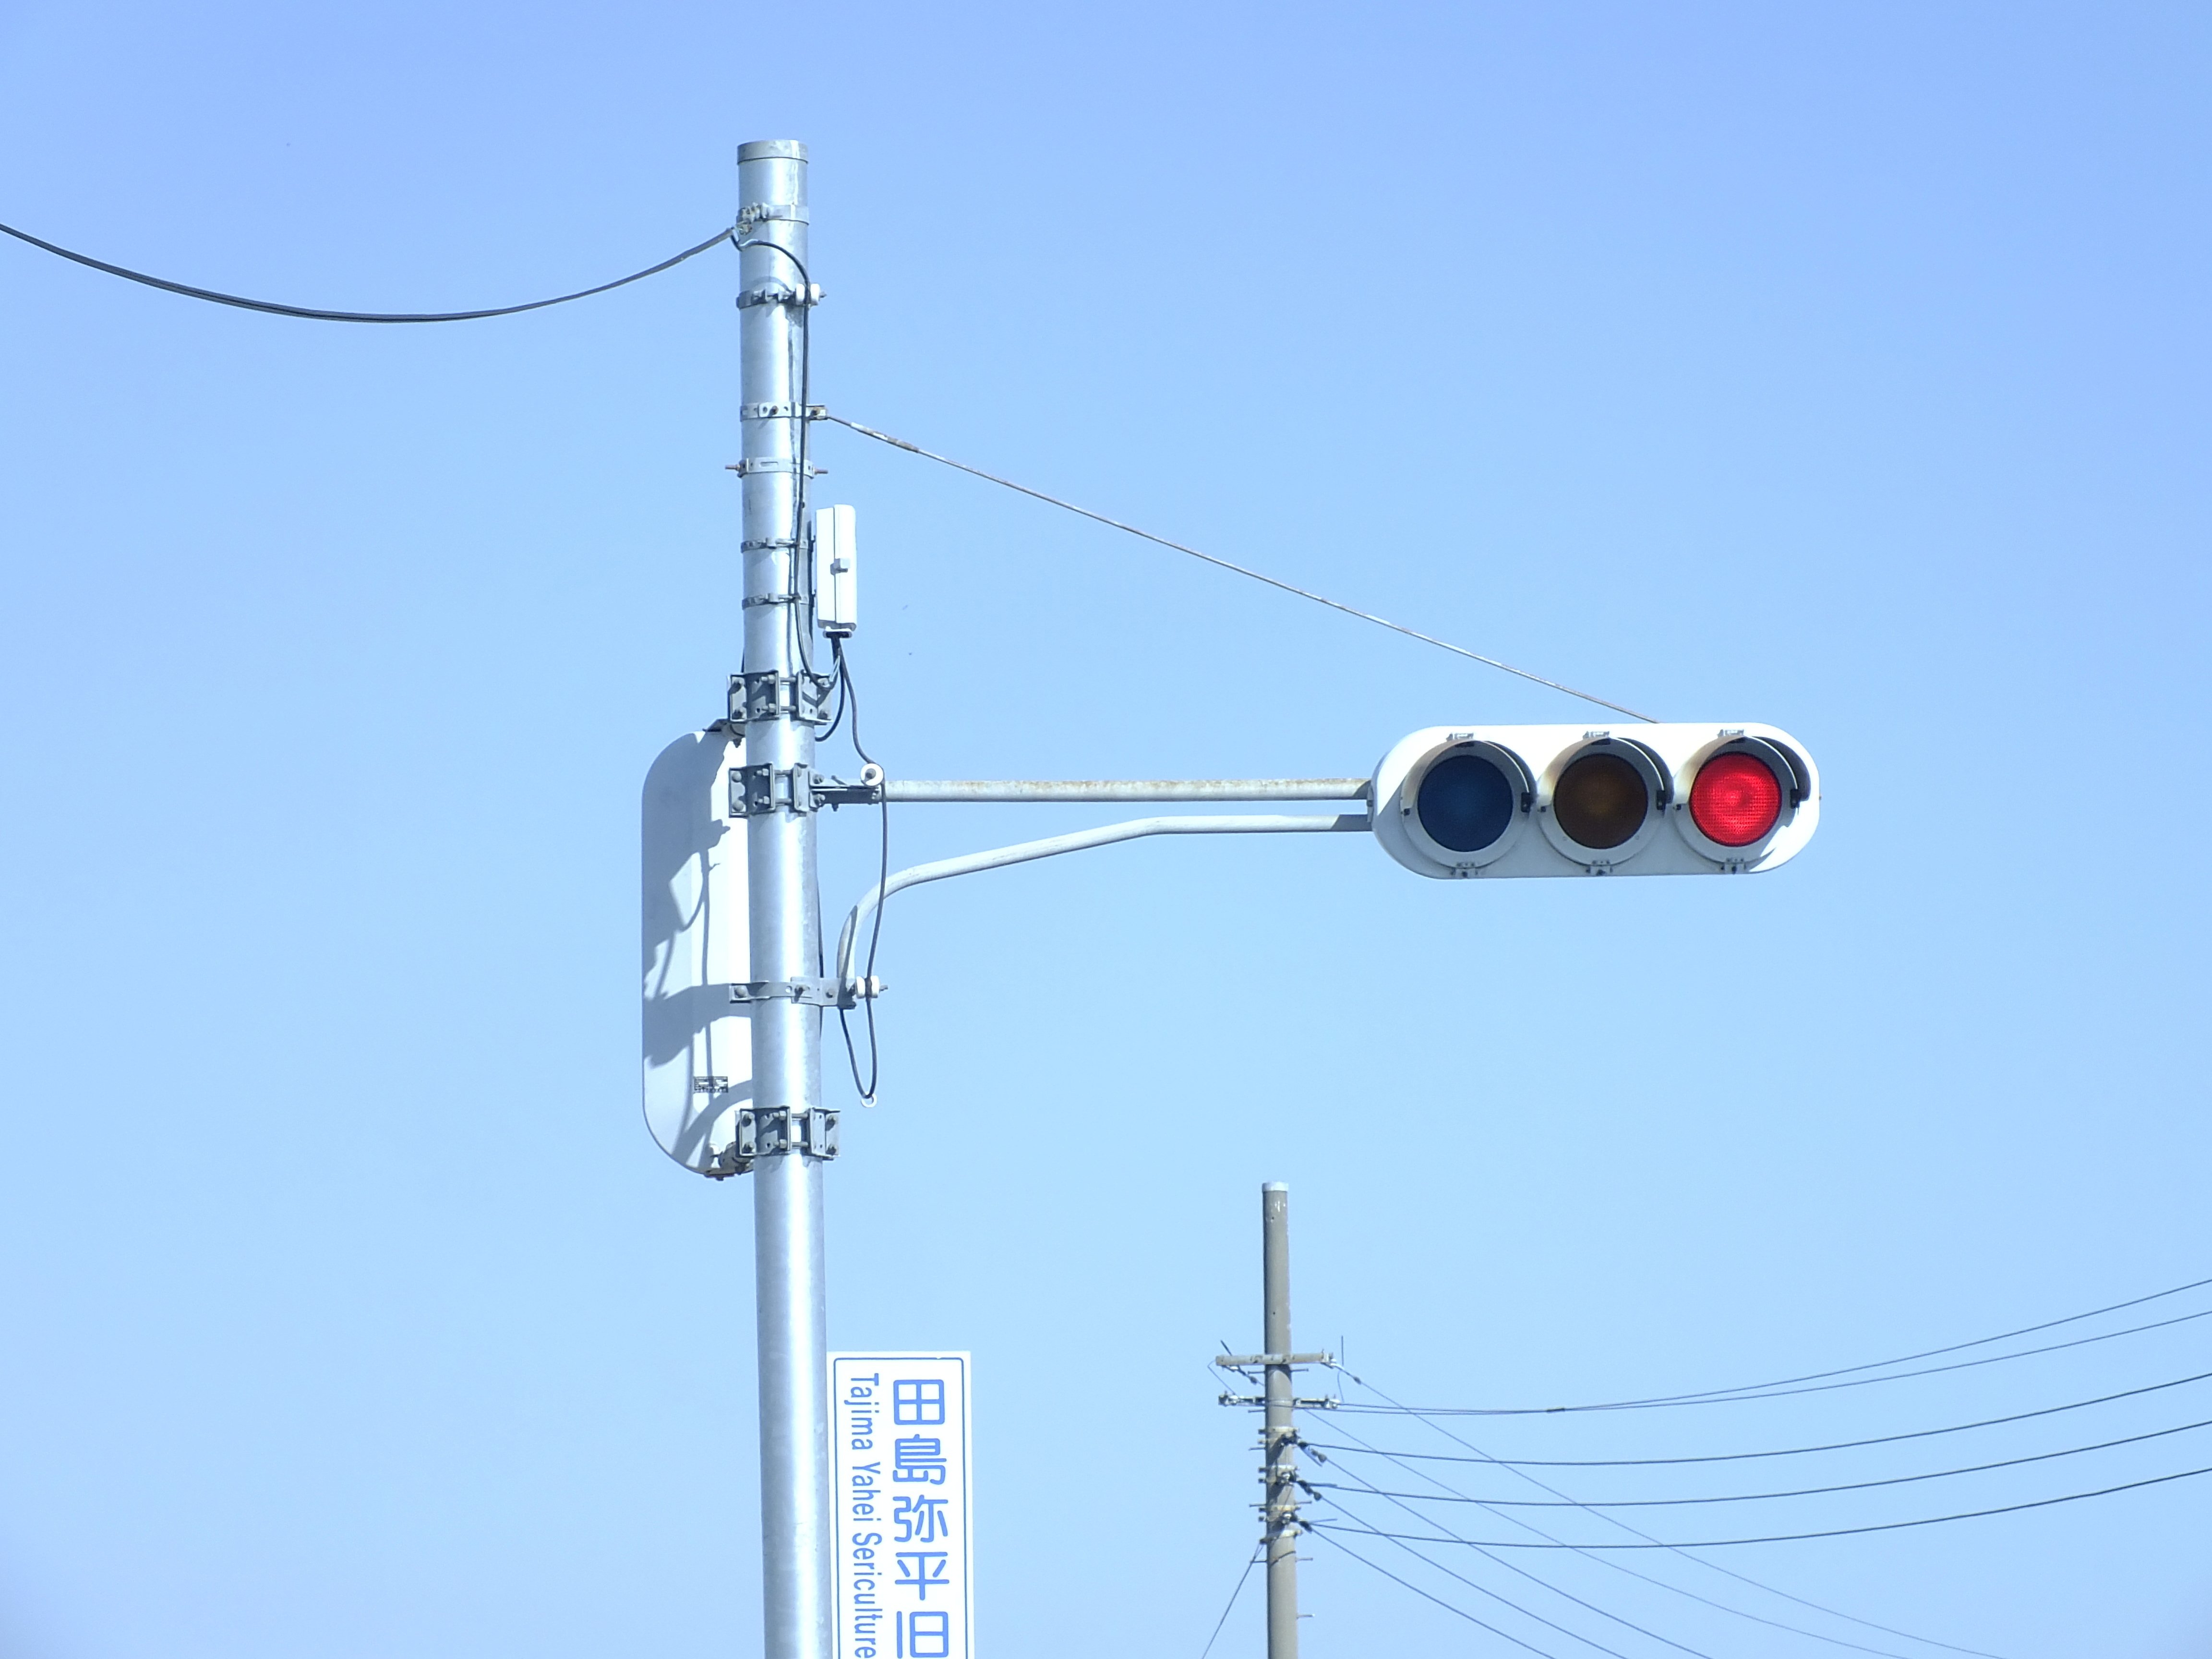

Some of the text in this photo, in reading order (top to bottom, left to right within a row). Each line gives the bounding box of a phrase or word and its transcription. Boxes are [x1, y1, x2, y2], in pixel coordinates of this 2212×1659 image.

[844, 1373, 883, 1659] Tajima Yahei Sericulture
[892, 1379, 950, 1659] 田島弥平旧
